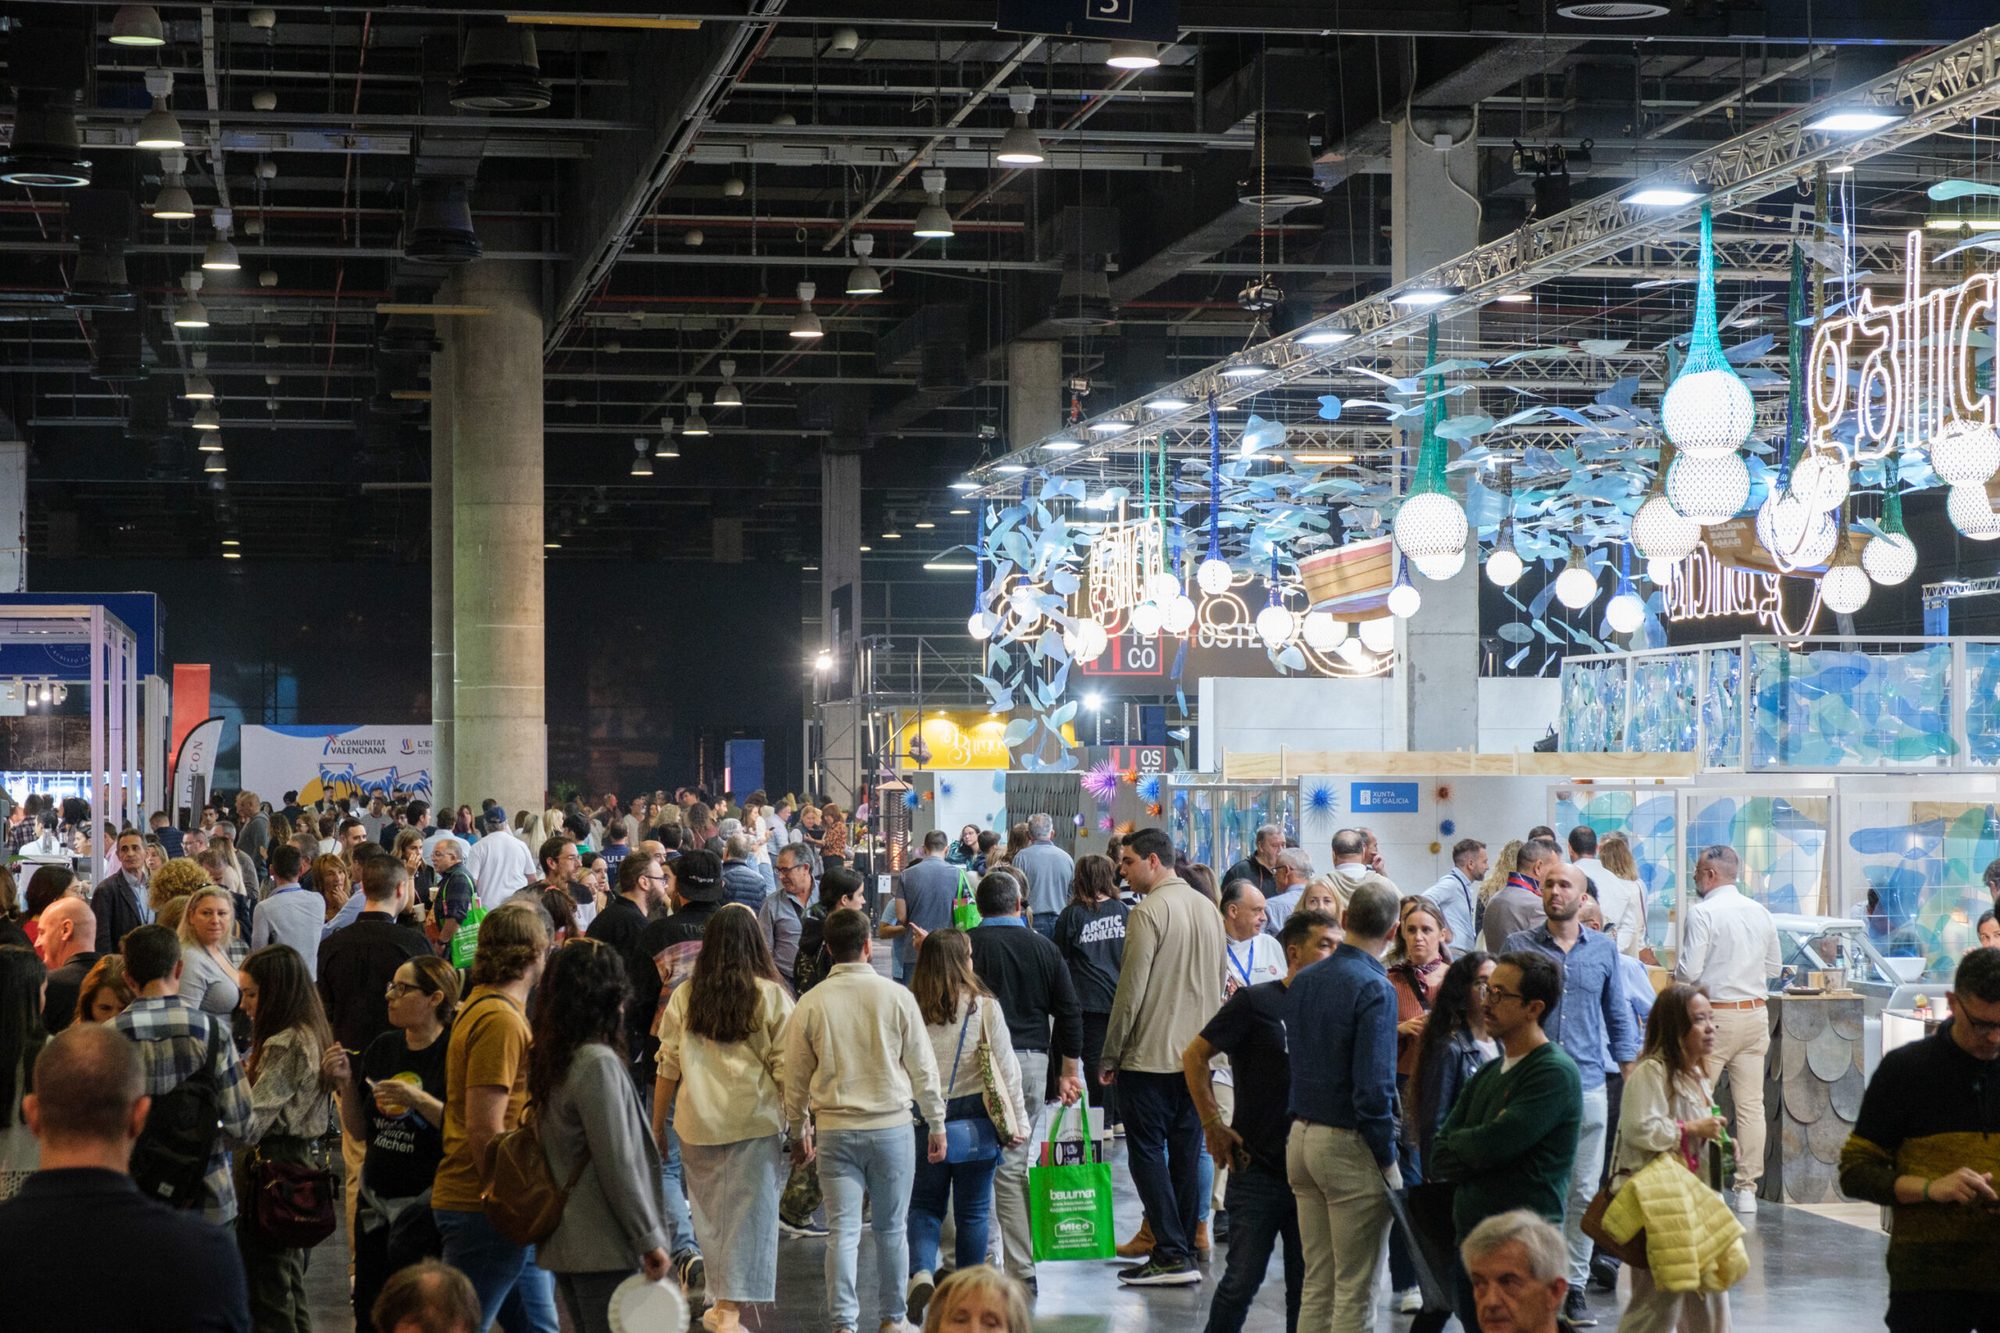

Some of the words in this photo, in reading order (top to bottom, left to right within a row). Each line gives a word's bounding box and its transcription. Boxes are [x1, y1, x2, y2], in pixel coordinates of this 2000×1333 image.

[1128, 647, 1156, 668] CO
[331, 747, 387, 755] VALENCIANA
[1141, 750, 1161, 765] OS
[1082, 915, 1122, 935] ARCTIC
[1079, 926, 1125, 944] MONKEYS
